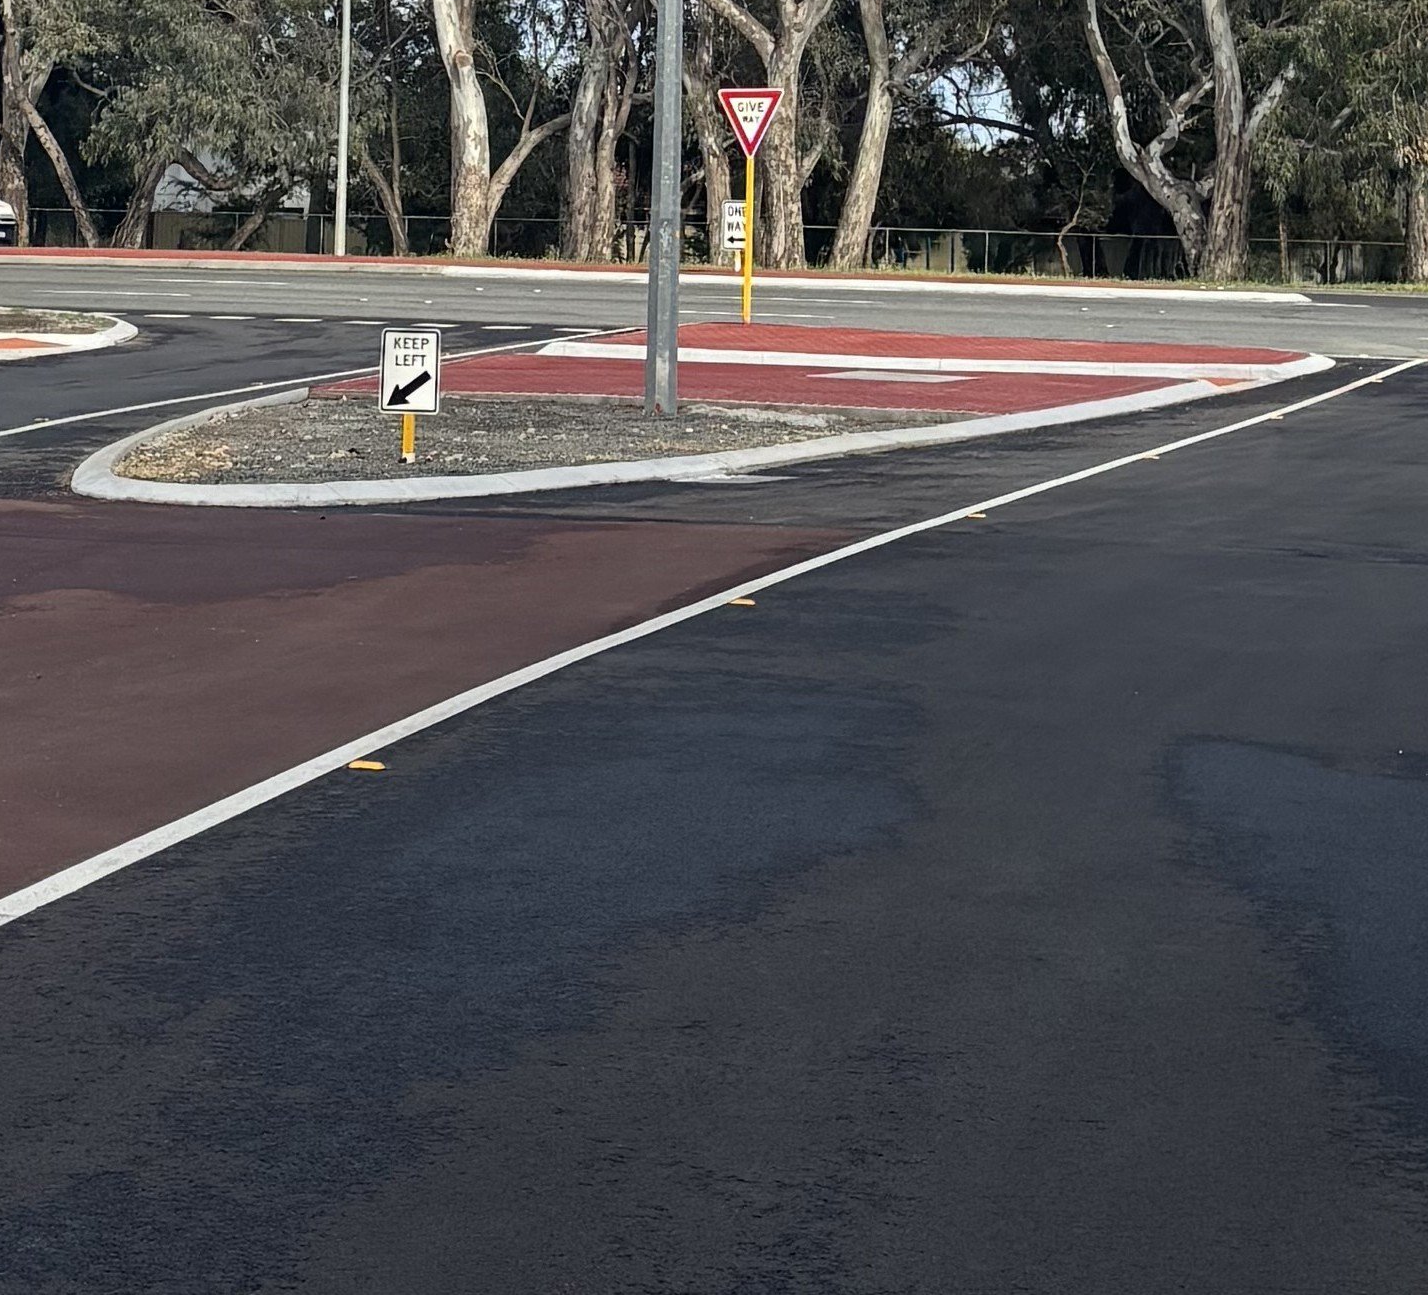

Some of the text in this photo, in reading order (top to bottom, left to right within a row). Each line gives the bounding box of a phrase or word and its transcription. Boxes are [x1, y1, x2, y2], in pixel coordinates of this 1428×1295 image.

[737, 101, 764, 112] GIVE
[742, 115, 760, 123] WAY
[393, 337, 430, 350] KEEP
[395, 354, 427, 367] LEFT
